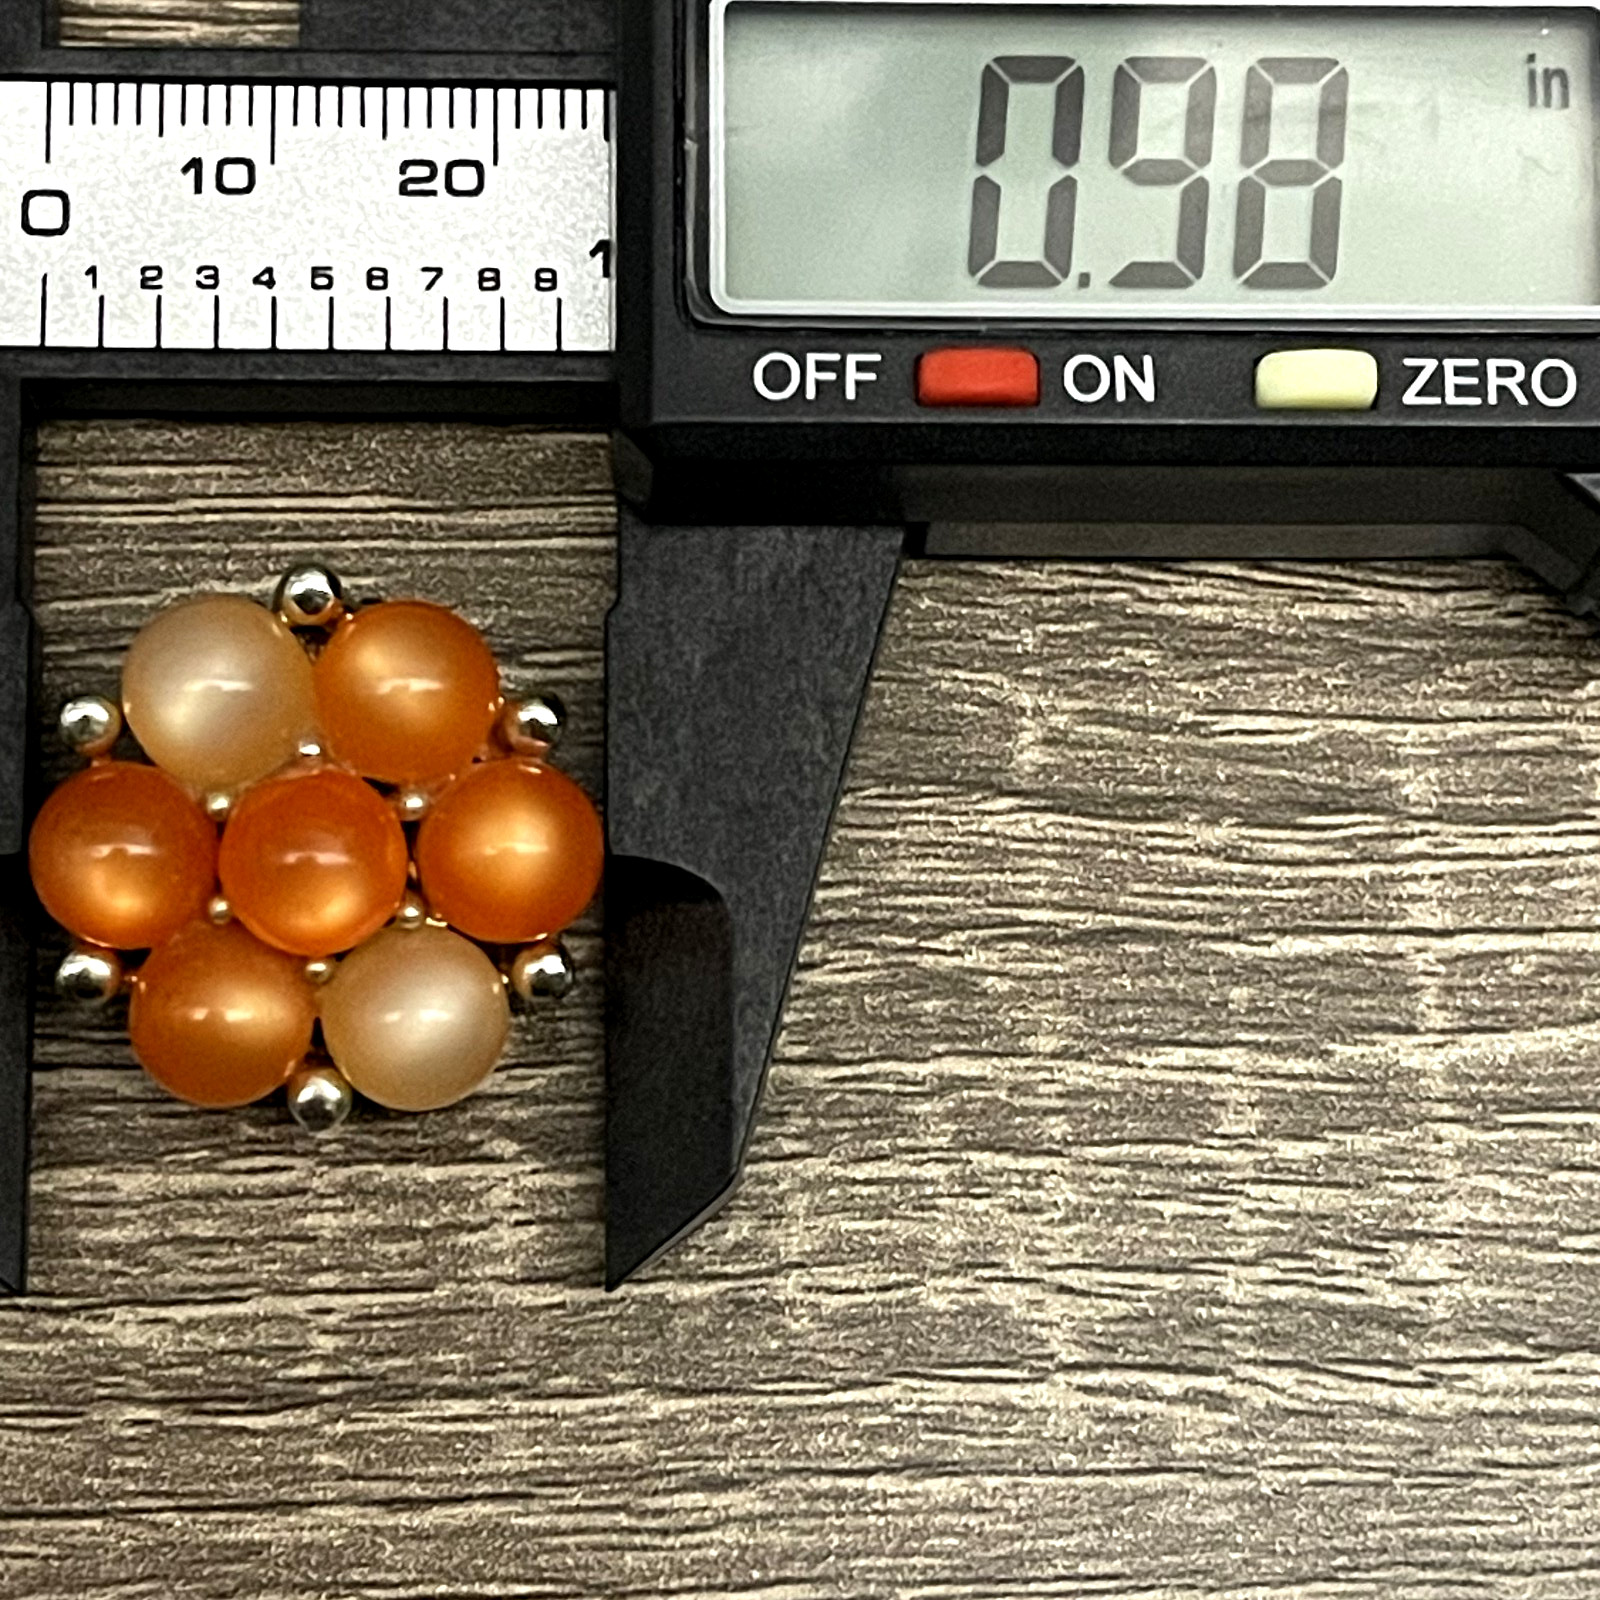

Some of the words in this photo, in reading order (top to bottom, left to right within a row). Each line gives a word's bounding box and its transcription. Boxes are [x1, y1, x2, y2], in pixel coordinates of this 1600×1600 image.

[1525, 52, 1570, 109] in
[180, 156, 256, 196] 10
[398, 158, 485, 198] 20
[967, 54, 1350, 290] 0.98
[20, 189, 71, 237] 0
[84, 265, 98, 289] 1
[140, 265, 163, 290] 2
[195, 264, 220, 290] 3
[252, 266, 277, 290] 4
[310, 266, 334, 291] 5
[420, 266, 444, 291] 7
[477, 267, 501, 292] 8
[752, 351, 882, 401] OFF
[1062, 354, 1156, 403] ON
[1400, 357, 1578, 407] ZERO
